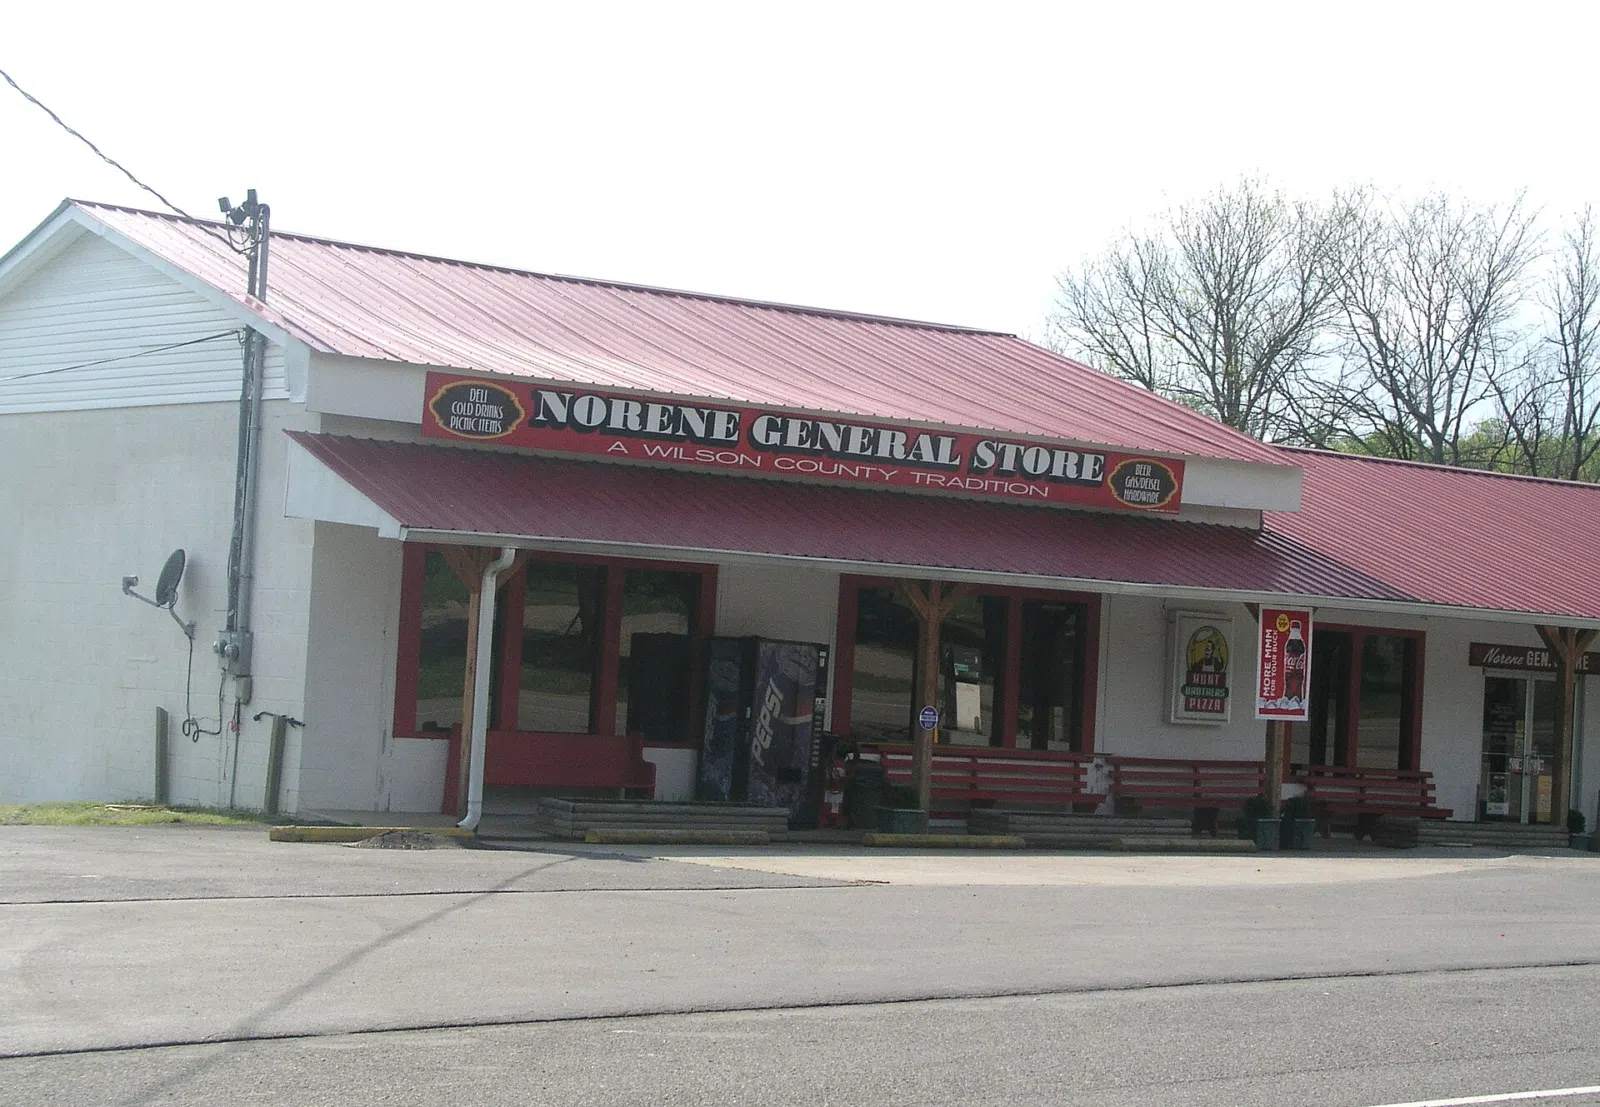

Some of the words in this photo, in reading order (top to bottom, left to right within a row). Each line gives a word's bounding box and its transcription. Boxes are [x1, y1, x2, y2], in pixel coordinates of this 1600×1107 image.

[469, 388, 488, 403] DELI
[451, 401, 474, 416] COLD
[475, 403, 504, 419] DRINKS
[450, 415, 477, 431] PICNIC
[478, 418, 502, 434] ITEMS
[533, 389, 741, 443] NORENE
[751, 413, 962, 467] GENERAL
[972, 440, 1105, 483] STORE
[607, 440, 629, 454] A
[643, 443, 761, 467] WILSON
[774, 456, 899, 481] COUNTY
[909, 471, 1049, 498] TRADITION
[1135, 463, 1152, 476] BEER
[1123, 488, 1160, 504] HARDWARE
[1264, 629, 1273, 658] MMM
[1526, 650, 1552, 668] GEN.
[1191, 673, 1221, 686] HUNT
[1263, 662, 1272, 697] MORE
[1189, 698, 1221, 711] PIZZA
[751, 677, 784, 767] PEPSI
